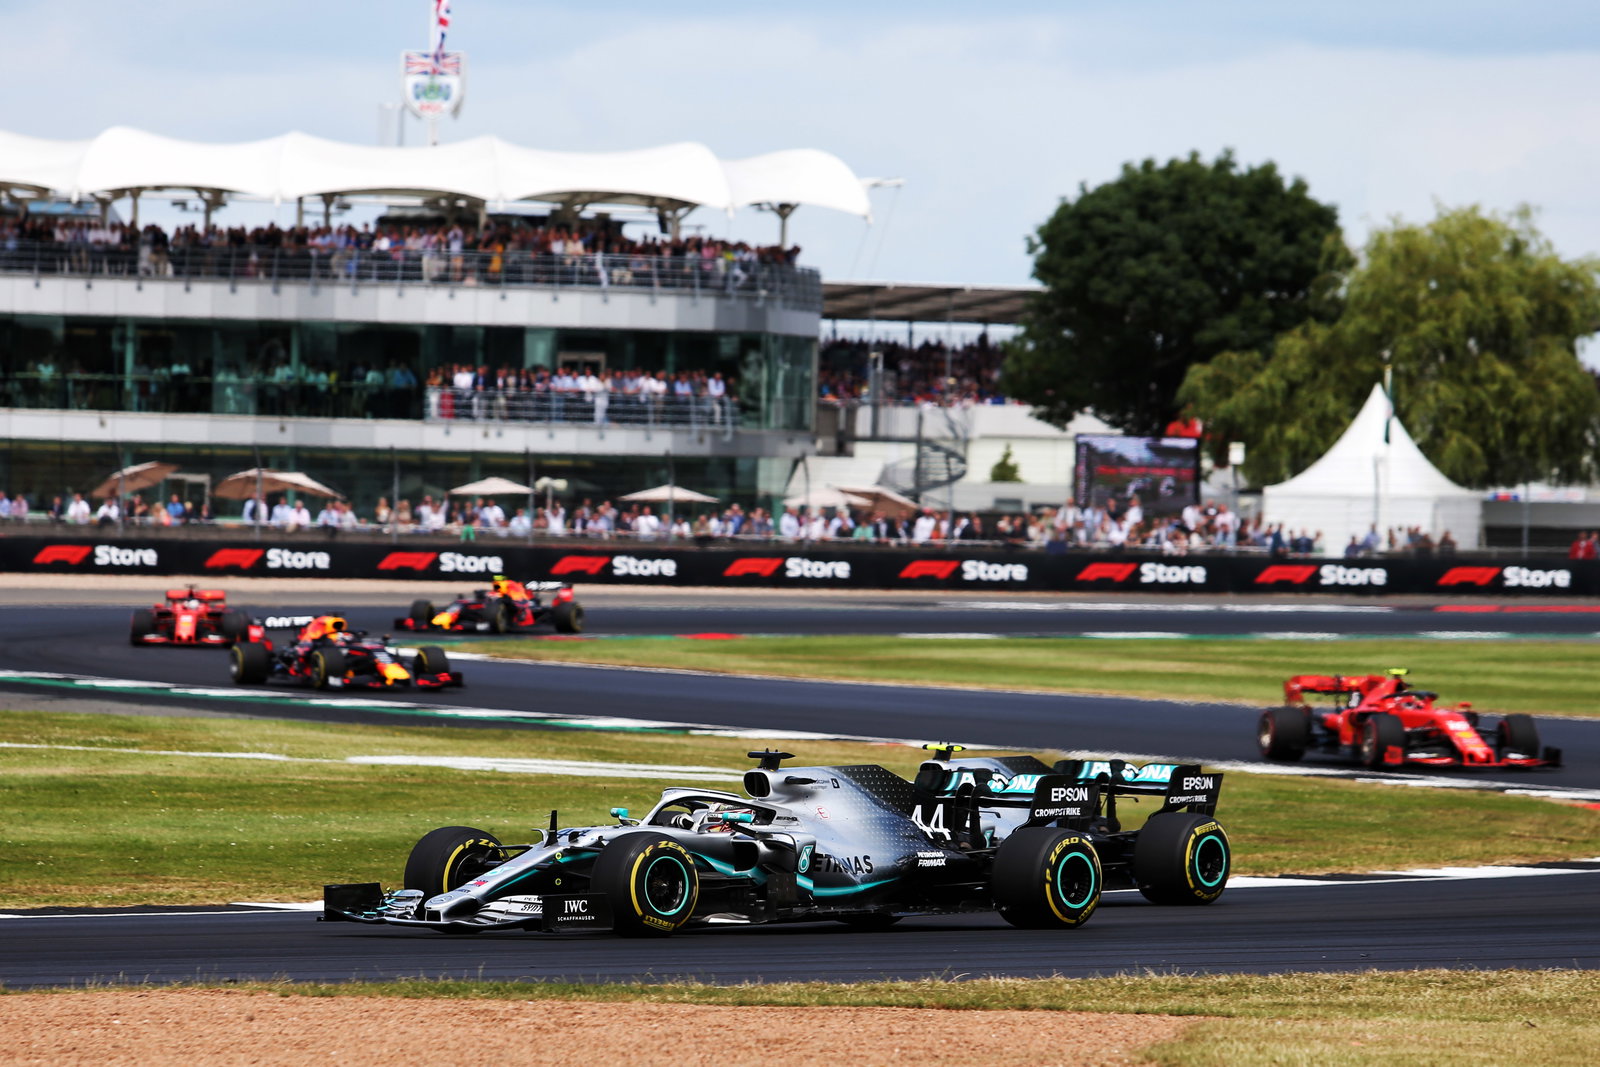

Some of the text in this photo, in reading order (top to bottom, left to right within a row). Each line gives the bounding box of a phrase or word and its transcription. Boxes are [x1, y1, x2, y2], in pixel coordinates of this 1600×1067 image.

[95, 545, 158, 566] Store
[266, 548, 331, 569] Store
[439, 552, 504, 573] Store
[612, 555, 677, 577] Store
[786, 558, 851, 579] Store
[961, 560, 1028, 582] Store
[1139, 562, 1207, 584] Store
[1319, 564, 1387, 586] Store
[1502, 566, 1571, 588] Store
[1183, 776, 1214, 791] EPSON
[1051, 787, 1089, 802] EPSON
[911, 803, 952, 841] 44
[1034, 807, 1081, 818] CROWDSTRIKE
[657, 840, 694, 865] ZERO
[1049, 836, 1080, 865] ZERO
[564, 899, 588, 914] IWC
